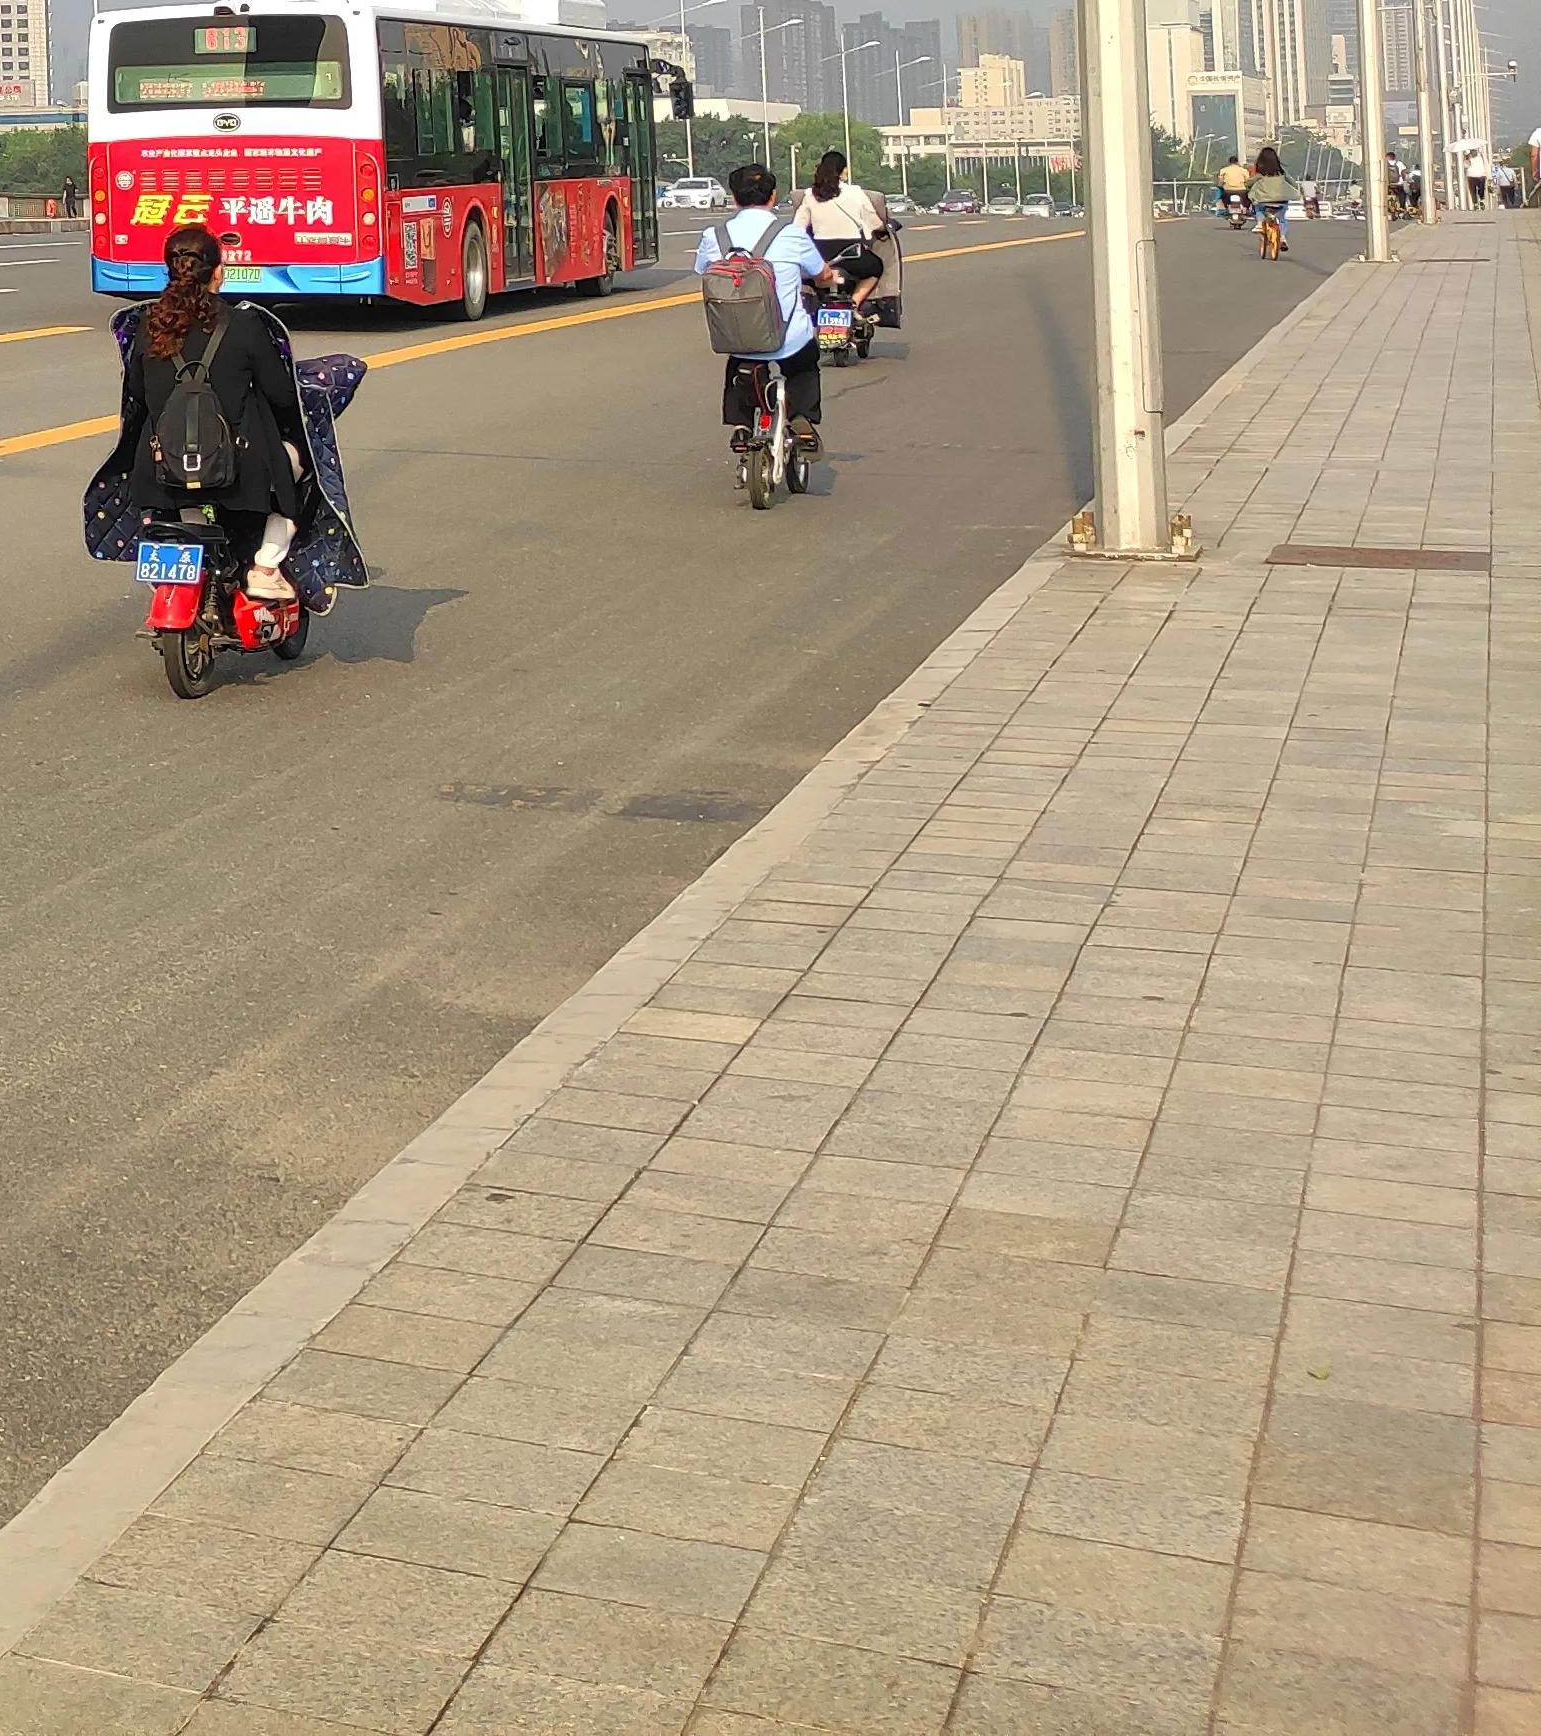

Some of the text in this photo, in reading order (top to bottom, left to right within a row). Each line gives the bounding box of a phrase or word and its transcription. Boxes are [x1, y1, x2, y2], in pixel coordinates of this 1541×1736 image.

[129, 193, 334, 226] 冠云 平遥牛肉
[148, 549, 192, 564] 太原
[140, 562, 197, 580] 821478
